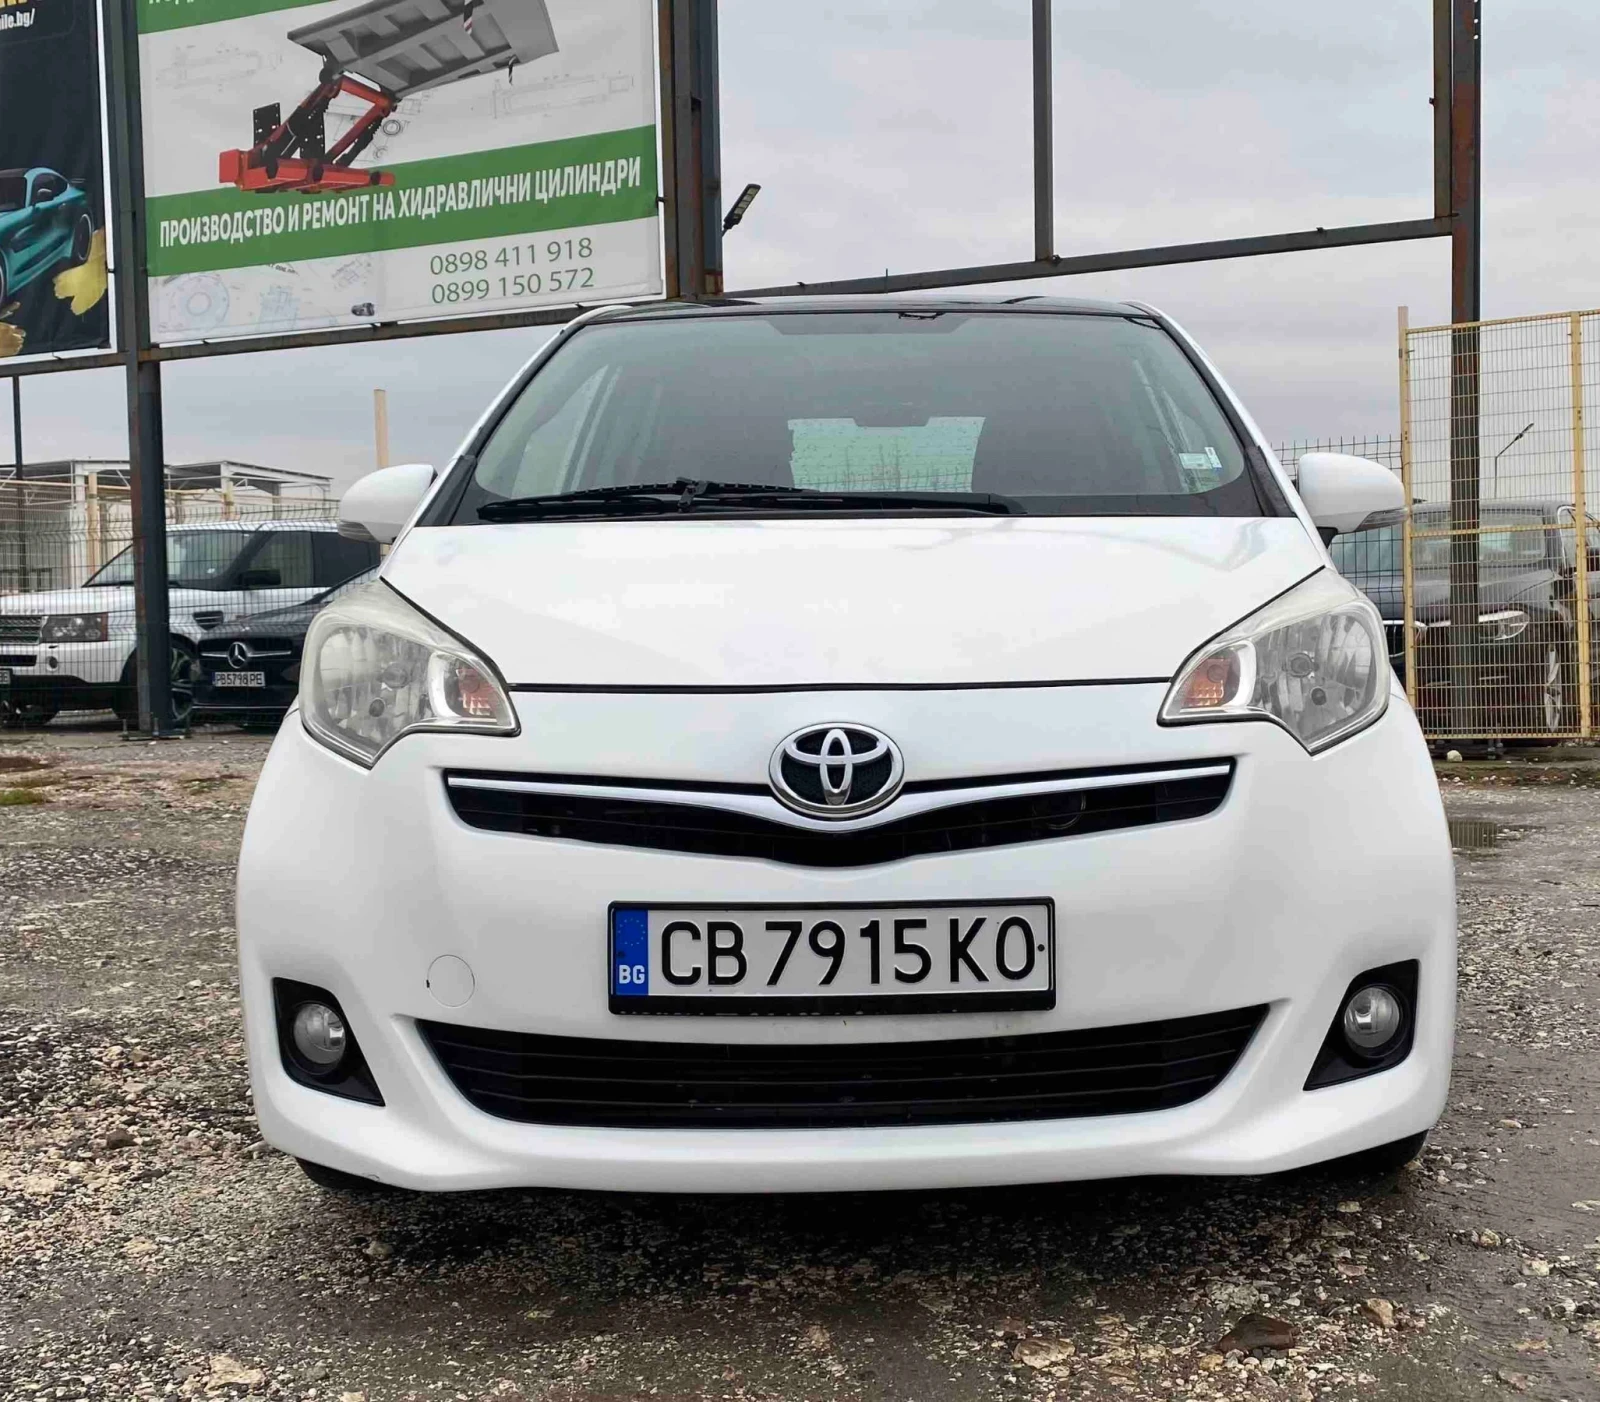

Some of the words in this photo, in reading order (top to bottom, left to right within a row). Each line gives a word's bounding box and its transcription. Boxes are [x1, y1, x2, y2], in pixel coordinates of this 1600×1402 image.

[0, 8, 35, 30] ile.bg/
[159, 206, 285, 247] ПРОИЗВОДСТВО
[288, 203, 299, 233] И
[302, 194, 370, 230] РЕМОНТ
[373, 191, 396, 221] НА
[398, 172, 531, 220] ХИДРАВЛИЧНИ
[535, 156, 641, 204] ЦИЛИНДРИ
[430, 249, 488, 275] 0898
[494, 243, 536, 268] 411
[547, 237, 593, 262] 918
[431, 279, 490, 304] 0899
[498, 273, 542, 297] 150
[549, 267, 594, 292] 572
[617, 964, 645, 985] BG
